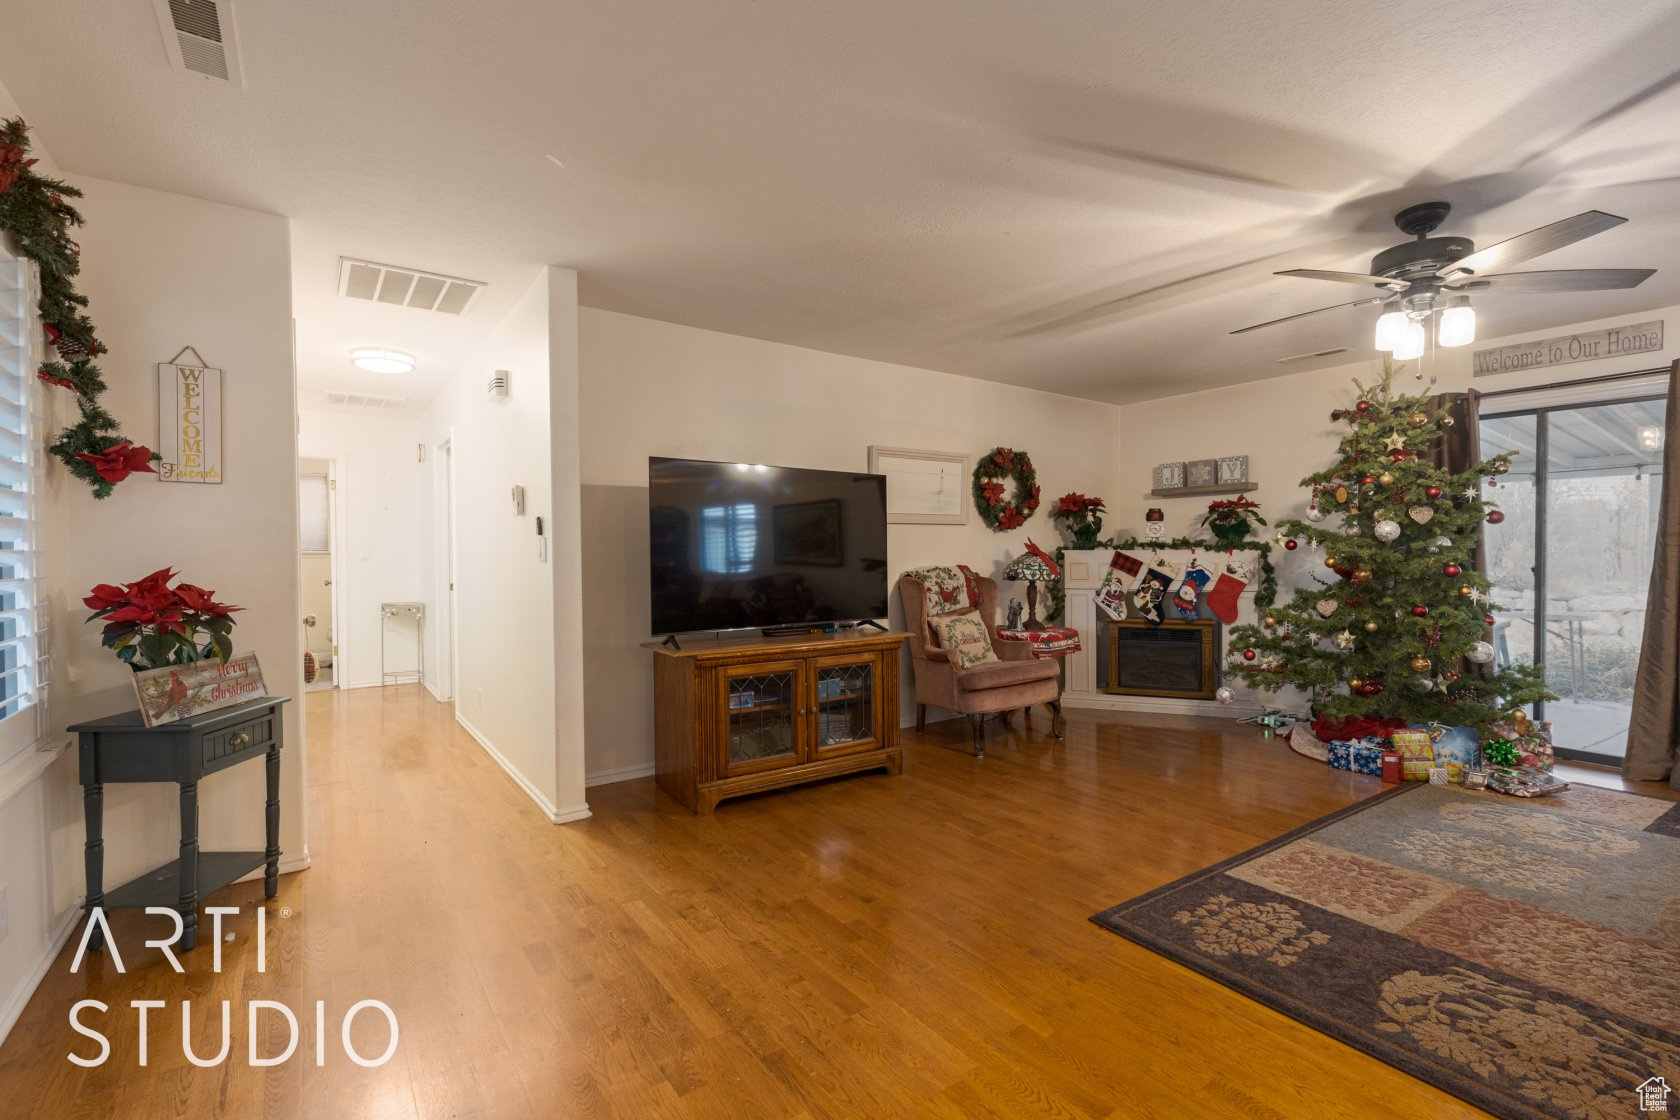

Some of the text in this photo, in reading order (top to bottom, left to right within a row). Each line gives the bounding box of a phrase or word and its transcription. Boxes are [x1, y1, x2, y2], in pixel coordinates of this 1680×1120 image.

[1478, 330, 1658, 373] Welcome to Our Home
[179, 367, 203, 468] WELCOME
[161, 463, 219, 480] Friends
[216, 662, 248, 678] Merry
[211, 679, 259, 701] Christmas
